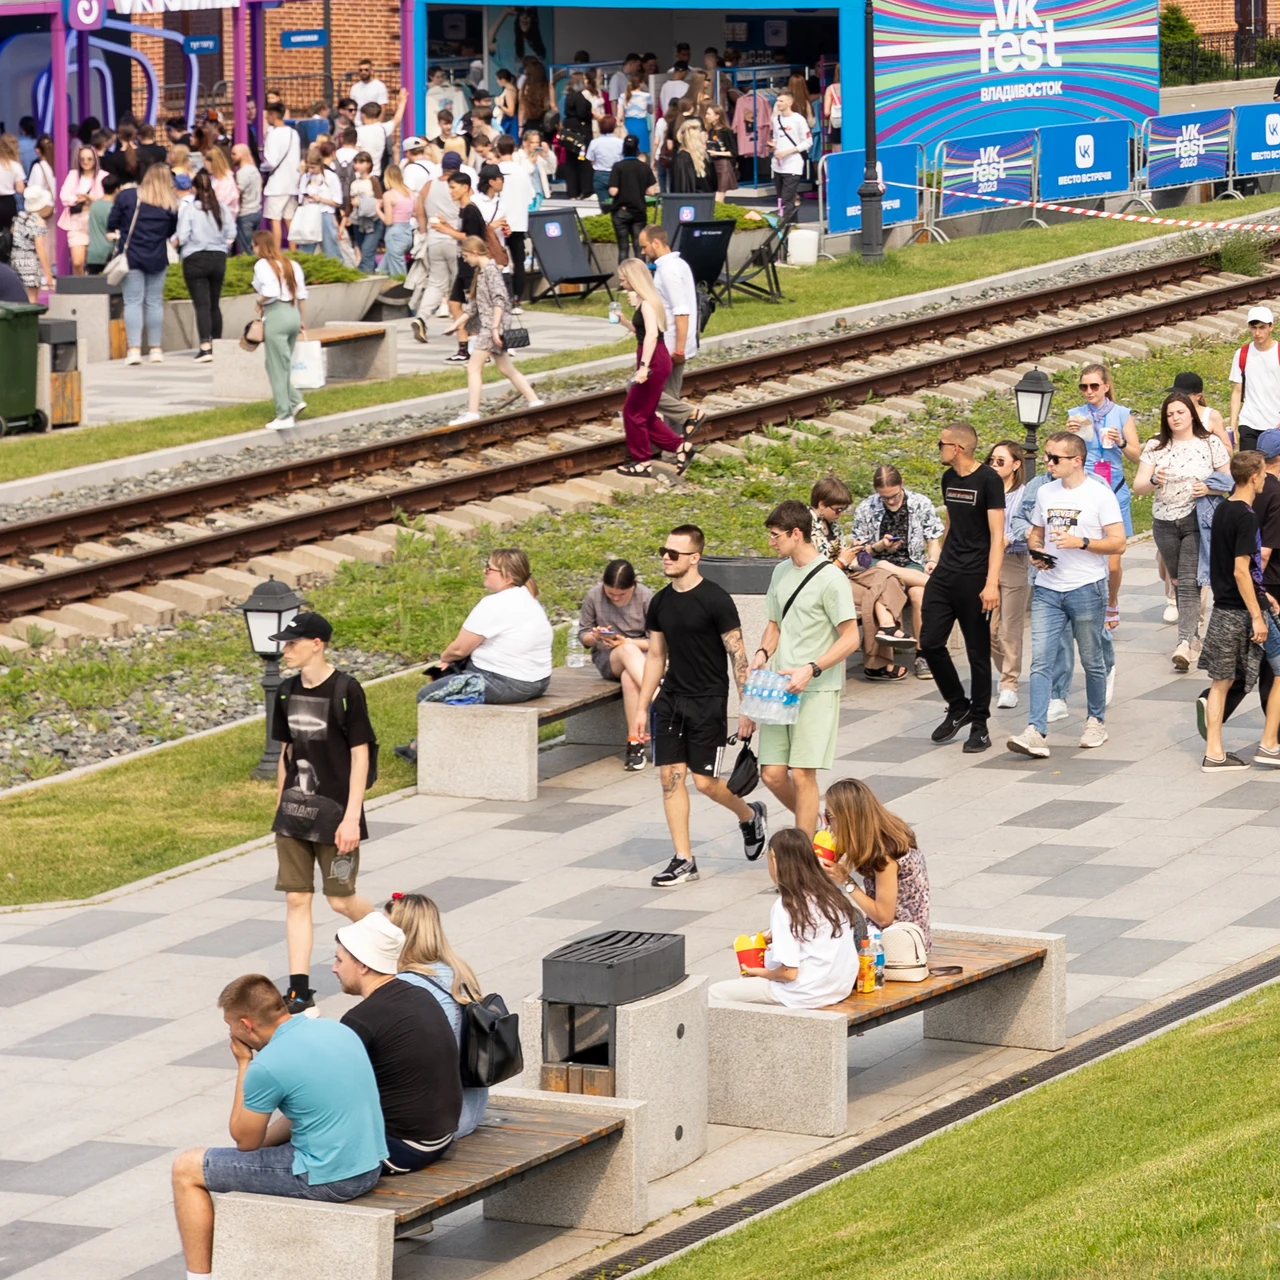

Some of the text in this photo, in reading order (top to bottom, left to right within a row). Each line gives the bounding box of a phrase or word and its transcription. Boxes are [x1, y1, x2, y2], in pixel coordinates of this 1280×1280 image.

[979, 19, 1062, 73] fest
[980, 80, 1063, 102] ВЛАДИВОСТОК
[1182, 123, 1200, 141] VK
[980, 145, 1001, 163] VK
[1079, 144, 1090, 158] VK
[1175, 134, 1206, 158] fest
[972, 158, 1006, 182] fest
[1180, 157, 1197, 168] 2023
[977, 181, 998, 193] 2023
